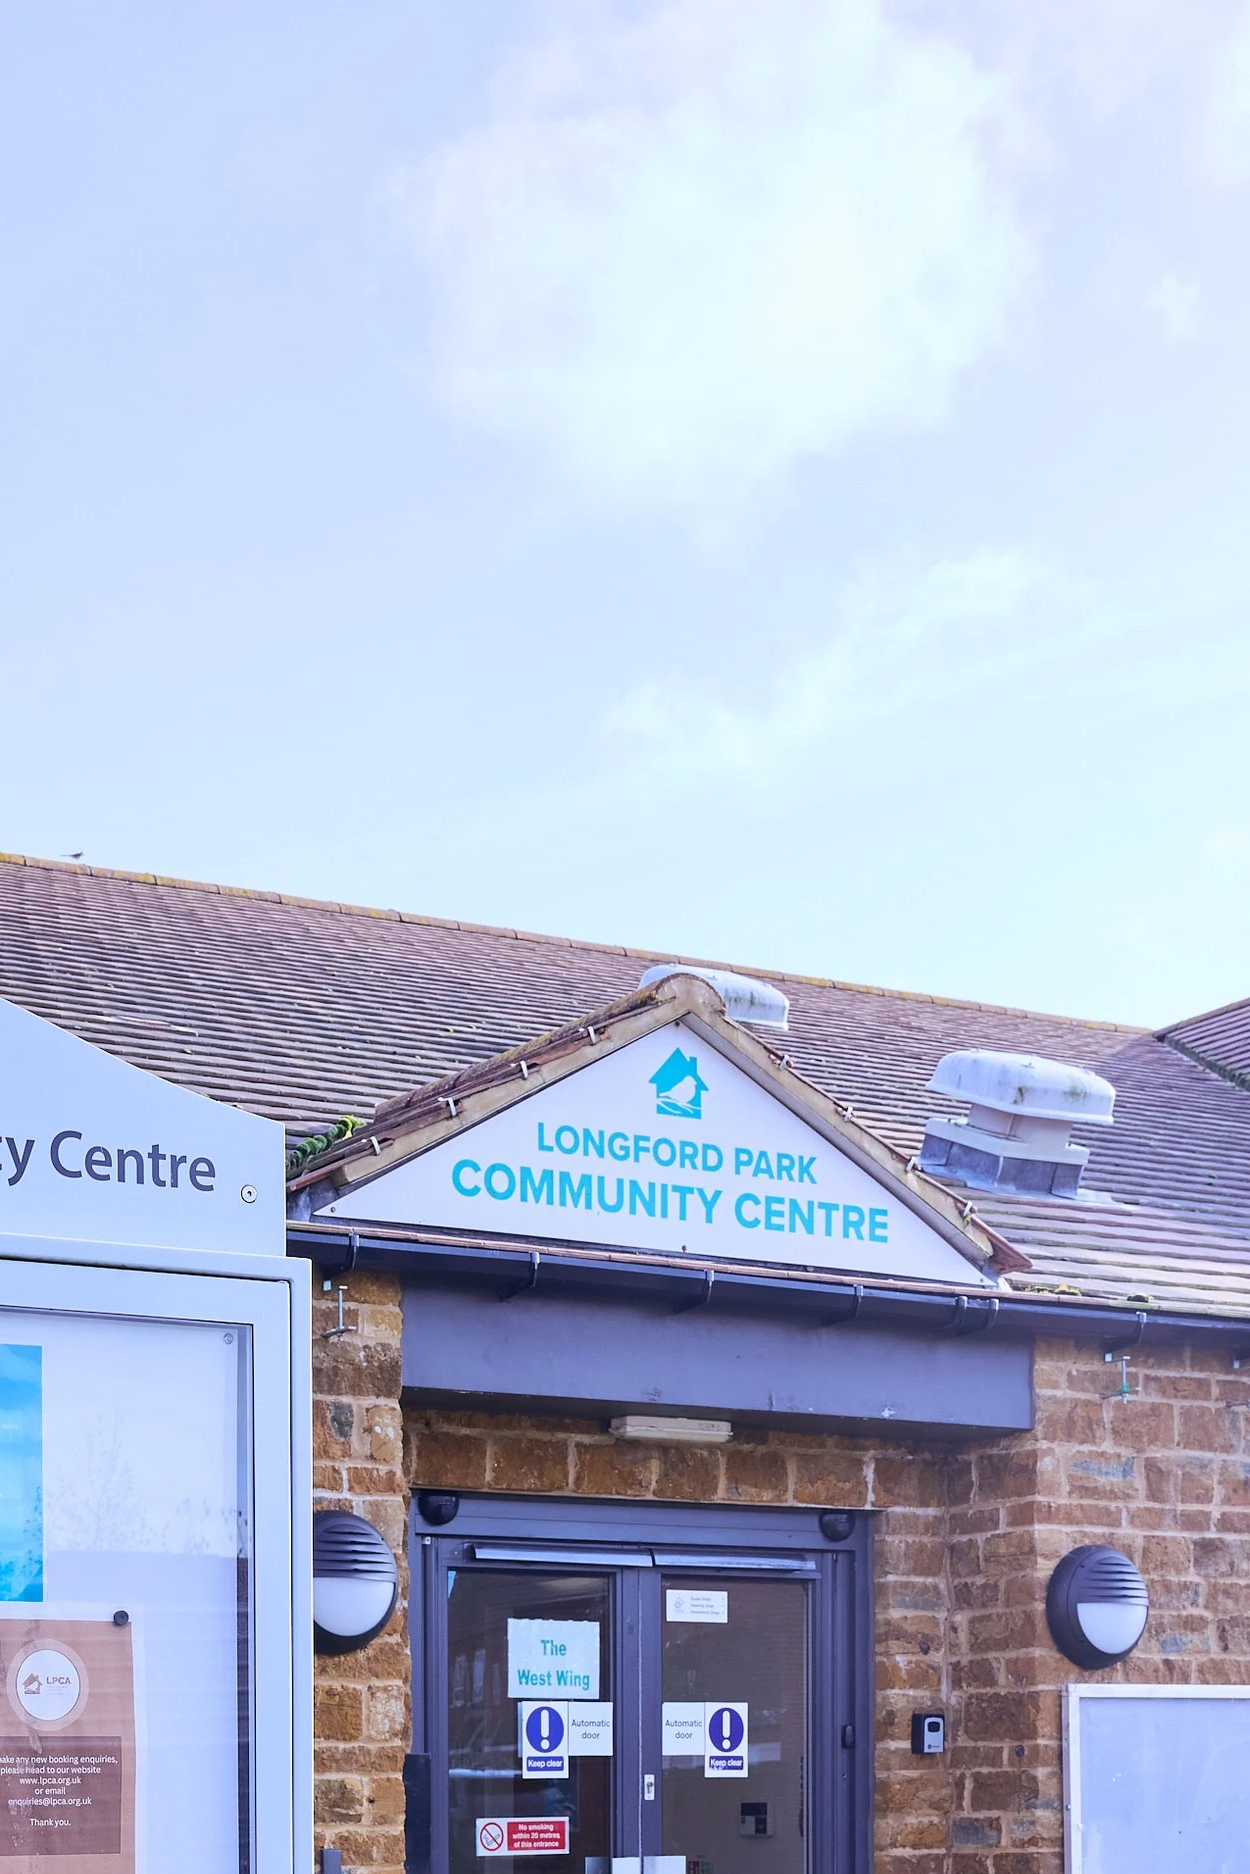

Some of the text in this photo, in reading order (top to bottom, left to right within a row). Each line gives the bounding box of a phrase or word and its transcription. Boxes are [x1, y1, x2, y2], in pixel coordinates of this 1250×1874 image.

[537, 1122, 819, 1185] LONGFORD PARK
[49, 1130, 217, 1192] Centre
[451, 1159, 889, 1244] COMMUNITY CENTRE
[540, 1639, 567, 1656] The
[46, 1676, 71, 1685] LPCA
[518, 1669, 590, 1691] West Wing
[571, 1719, 611, 1728] Automatic
[665, 1719, 703, 1728] Automatic
[581, 1730, 600, 1739] door
[675, 1731, 693, 1740] door
[15, 1757, 30, 1765] any
[48, 1755, 79, 1765] booking
[80, 1755, 118, 1764] enquiries,
[527, 1759, 563, 1769] Keep clear
[710, 1758, 743, 1767] Keep clear
[0, 1766, 25, 1775] please
[25, 1766, 45, 1774] head
[70, 1765, 101, 1774] website
[19, 1776, 82, 1786] www.lpca.org.uk
[45, 1786, 66, 1795] email
[8, 1797, 92, 1807] enquiries@lpca.org.uk
[30, 1818, 71, 1828] Thank you.
[528, 1824, 554, 1832] smoking
